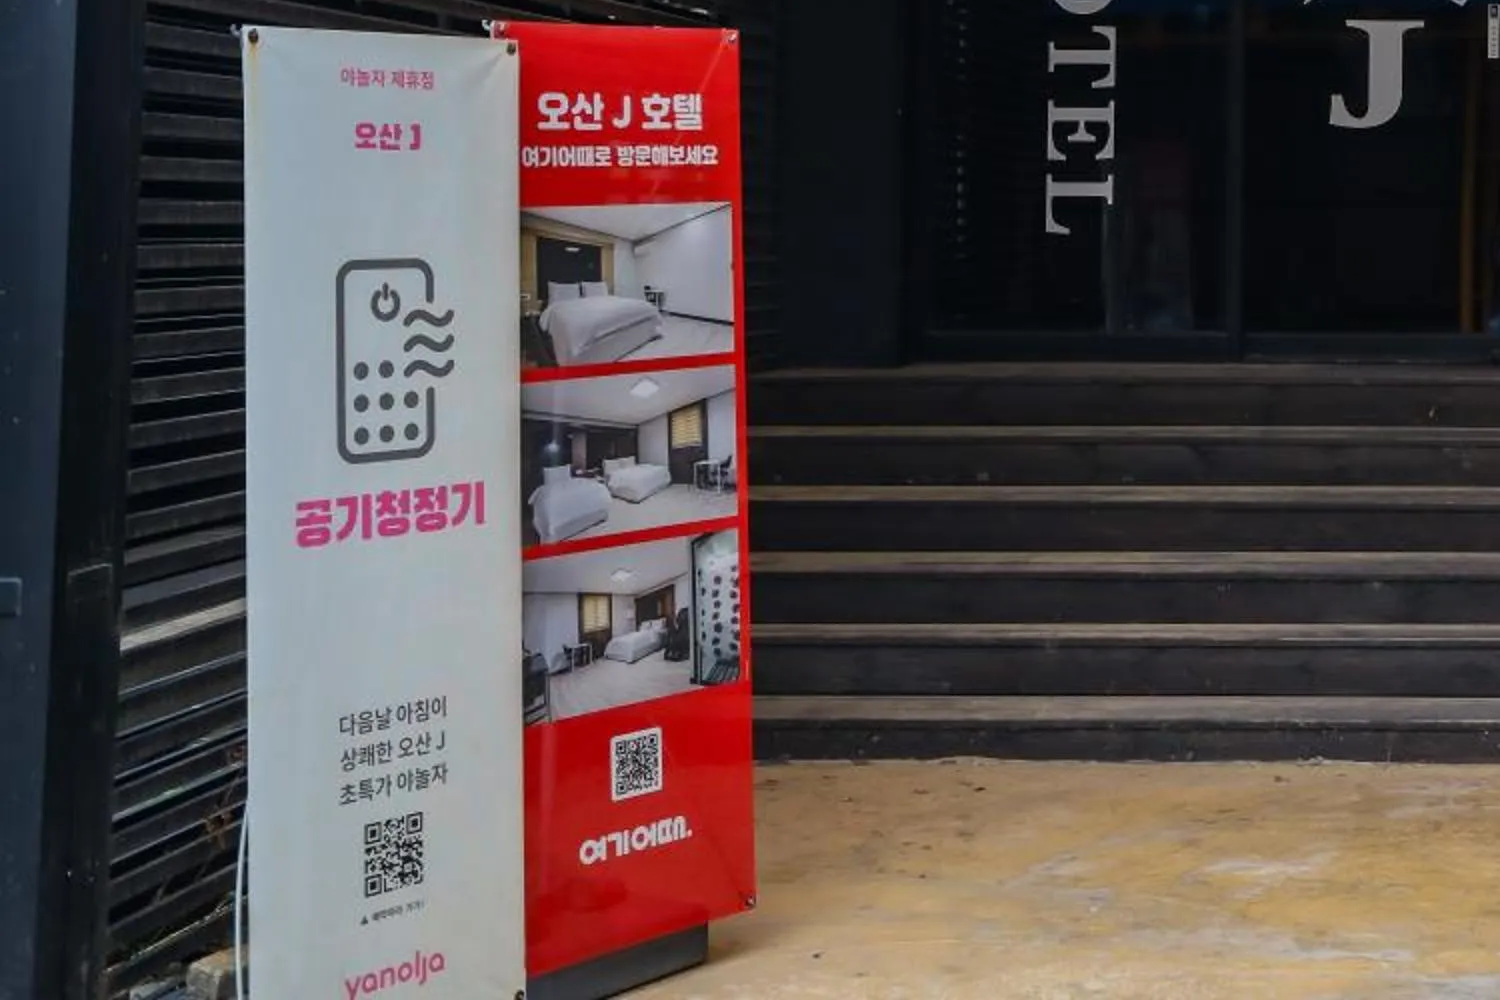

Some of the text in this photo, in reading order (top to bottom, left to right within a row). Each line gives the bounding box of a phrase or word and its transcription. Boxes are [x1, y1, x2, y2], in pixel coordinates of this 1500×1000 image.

[341, 67, 385, 88] 야놀자
[1329, 19, 1424, 128] J
[537, 91, 703, 131] 오산 J 호텔
[355, 122, 402, 151] 오산
[521, 144, 719, 168] 여기어때로 방문해보세요
[295, 480, 485, 548] 공기청정기
[339, 695, 447, 736] 다음날 아침이
[340, 730, 446, 772] 상쾌한 오산 J
[339, 762, 448, 806] 초특가 야놀자
[344, 950, 445, 1000] yanolja
